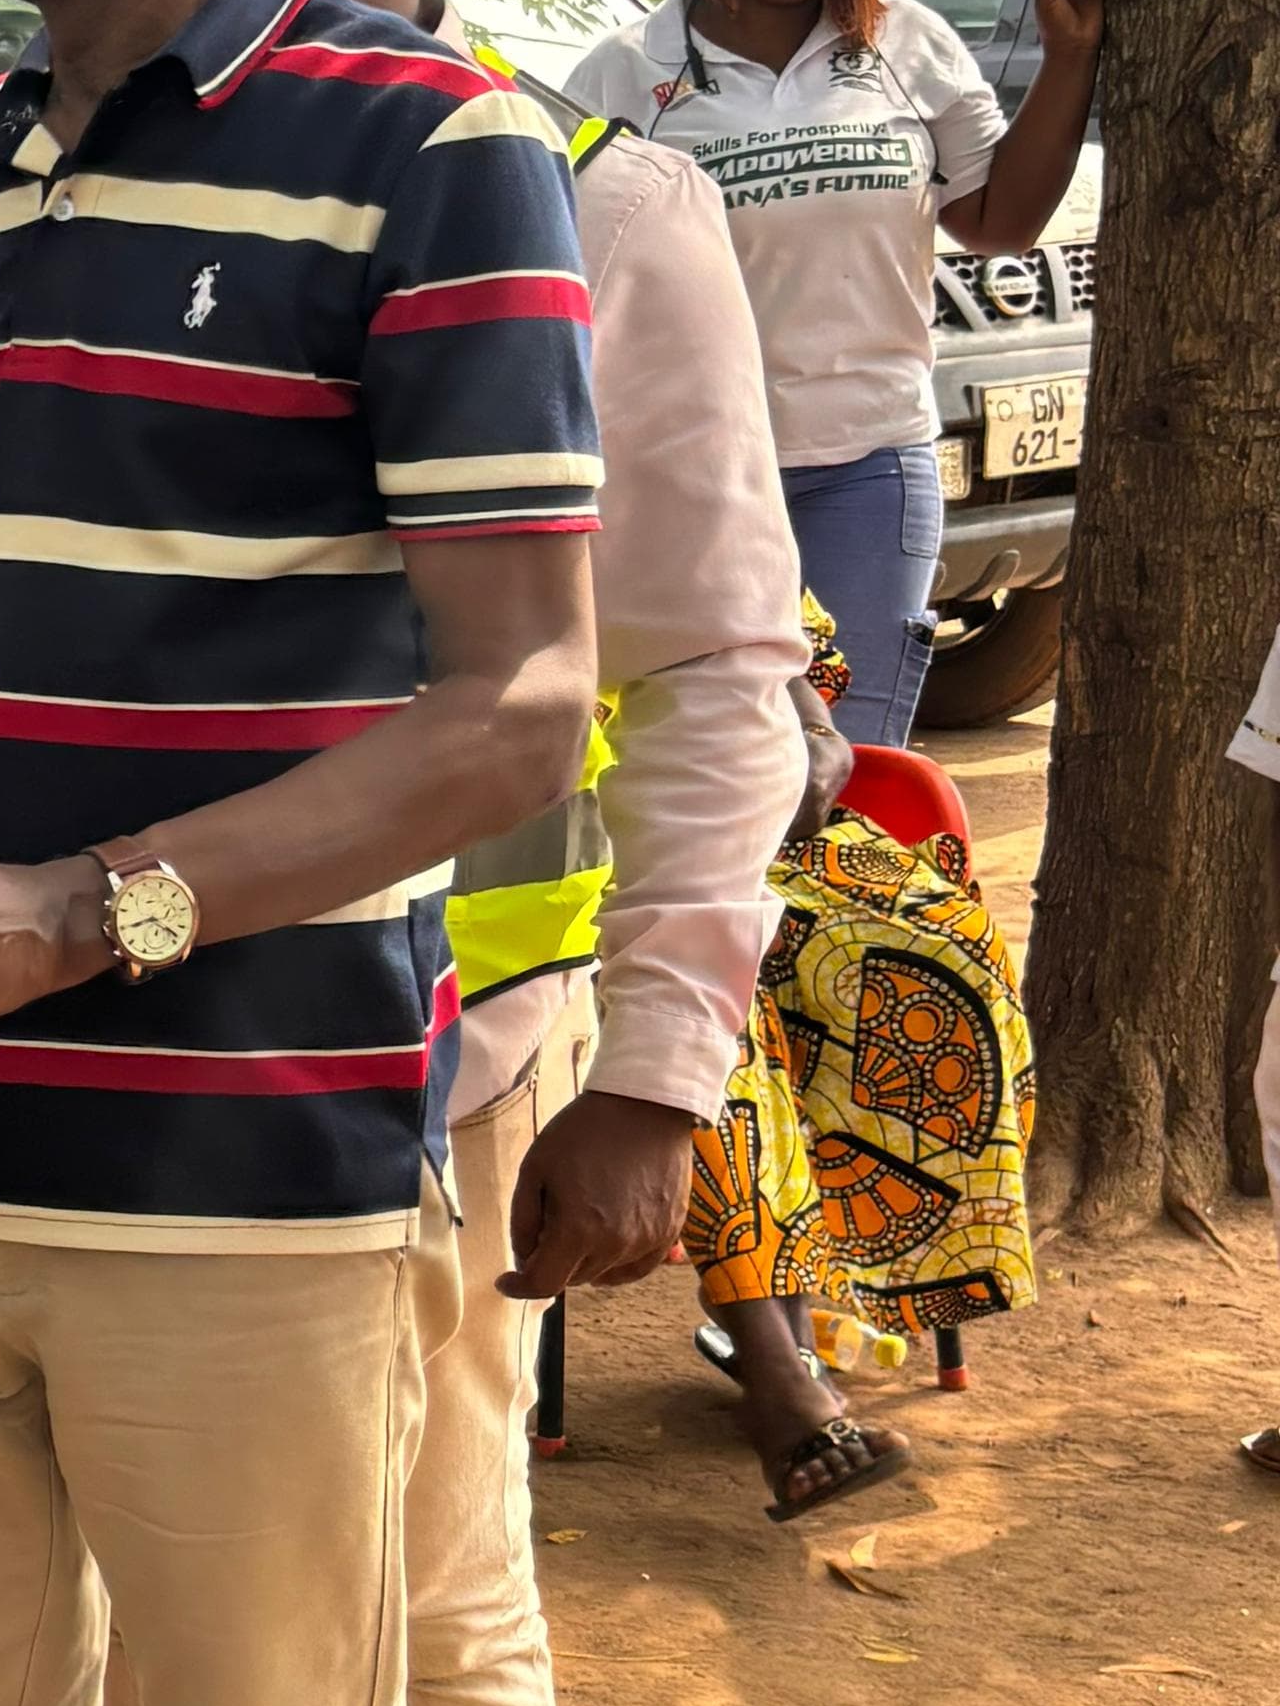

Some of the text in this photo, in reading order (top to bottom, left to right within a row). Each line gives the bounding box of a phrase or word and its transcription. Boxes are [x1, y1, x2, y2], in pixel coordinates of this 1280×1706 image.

[691, 135, 742, 159] Skills
[746, 129, 781, 146] For
[705, 142, 907, 182] MPOWERING
[1030, 385, 1065, 424] GN
[1011, 426, 1084, 468] 621-
